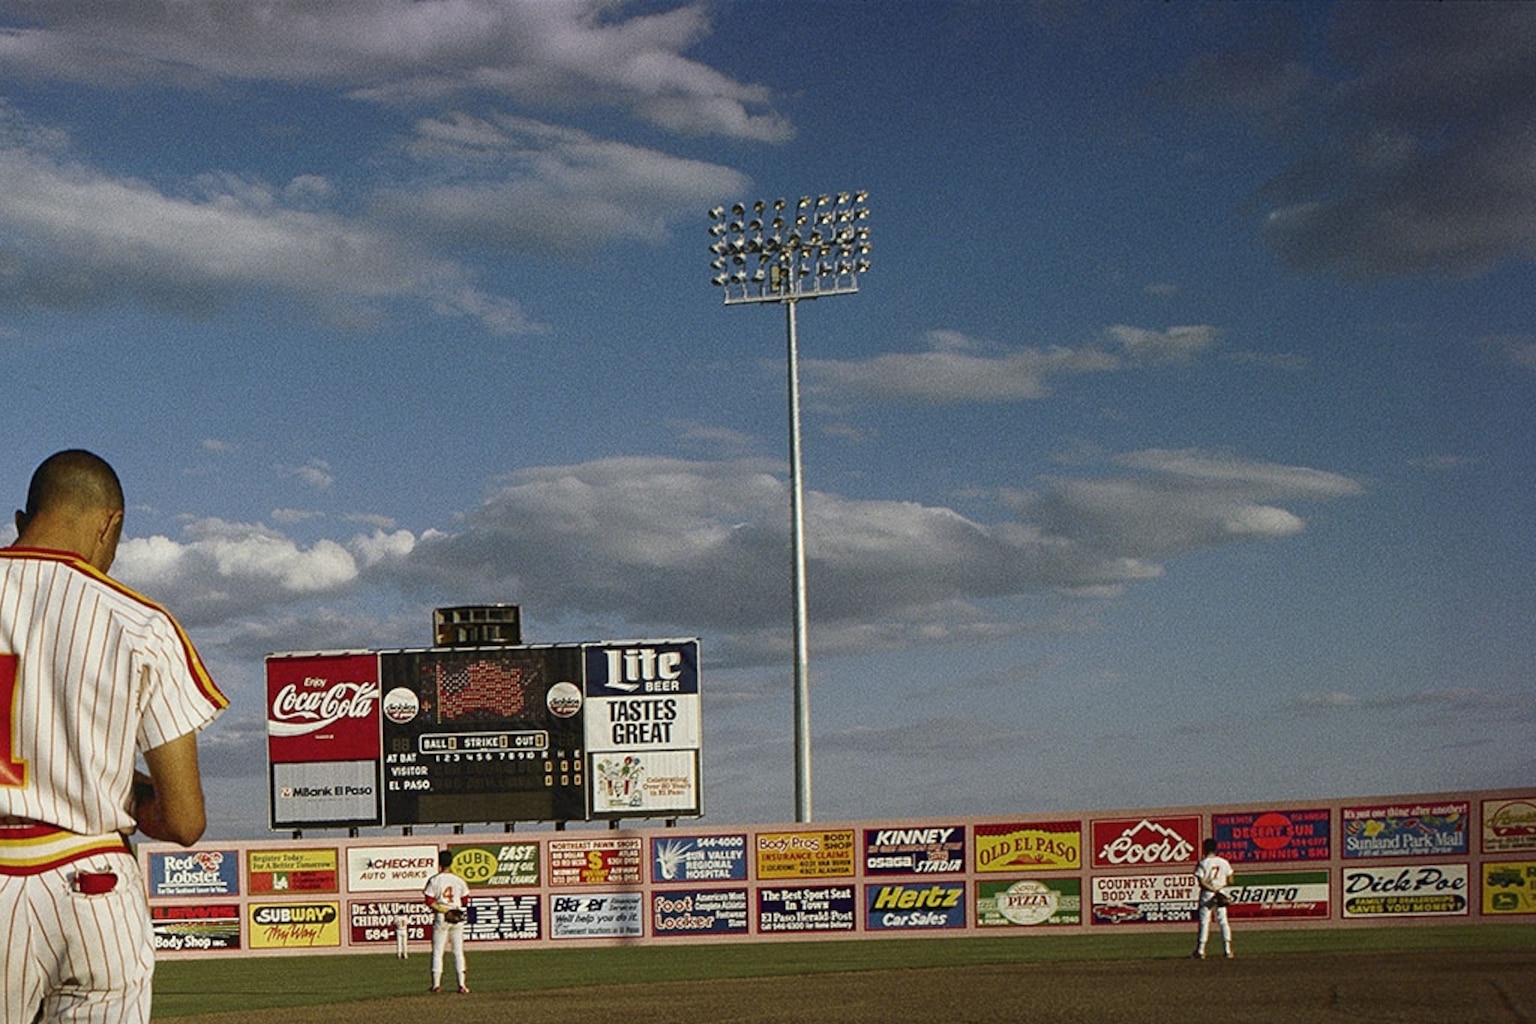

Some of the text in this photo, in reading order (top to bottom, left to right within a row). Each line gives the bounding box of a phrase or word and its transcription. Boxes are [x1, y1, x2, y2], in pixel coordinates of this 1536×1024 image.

[603, 649, 681, 692] Lite
[303, 676, 328, 688] Enjoy
[645, 680, 680, 692] BEER
[606, 699, 677, 722] TASTES
[612, 722, 673, 745] GREAT
[423, 736, 534, 749] BALL STRIKE OUT
[386, 753, 416, 763] AT BAT
[391, 766, 428, 776] VISITOR
[292, 786, 372, 797] MBank El Paso
[389, 779, 431, 791] EL PASO
[875, 828, 955, 846] KINNEY
[1232, 824, 1314, 838] DESERT SUN
[759, 834, 852, 853] Body Pros BODY
[824, 842, 852, 850] SHOP
[1347, 831, 1464, 851] Sunland Park Mall
[497, 845, 534, 861] FAST
[707, 850, 743, 860] VALLEY
[761, 851, 850, 861] INSURANCE CLAIMS
[979, 842, 1010, 866] OLD
[1014, 836, 1032, 852] EL
[1035, 836, 1077, 863] PASO
[1098, 835, 1195, 864] Coors
[1254, 849, 1299, 859] TENNIS
[164, 856, 194, 870] Red
[374, 857, 435, 869] CHECKER
[457, 852, 491, 866] LUBE
[686, 860, 733, 870] REGIONAL
[914, 859, 963, 873] STADIA
[164, 870, 221, 884] Lobster
[360, 871, 428, 880] AUTO WORKS
[463, 866, 490, 879] GO
[686, 869, 732, 879] HOSPITAL
[1211, 866, 1220, 880] 7
[1098, 877, 1196, 890] COUNTRY CLUB
[1346, 867, 1466, 895] Dick Poe
[442, 886, 454, 904] 4
[761, 887, 852, 901] The Best Sport Seat
[874, 886, 963, 909] Hertz
[1007, 895, 1048, 907] PIZZA
[1102, 888, 1193, 901] BODY & PAINT
[1229, 886, 1298, 903] sbarro
[553, 897, 608, 913] Blazer
[785, 900, 830, 911] In Town
[1348, 905, 1384, 914] SAVES
[1387, 904, 1410, 913] YOU
[256, 906, 334, 923] SUBWAY
[654, 912, 715, 930] Locker
[761, 912, 772, 922] El
[772, 911, 796, 923] Paso
[882, 911, 948, 927] Car Sales
[155, 934, 212, 950] Body Shop
